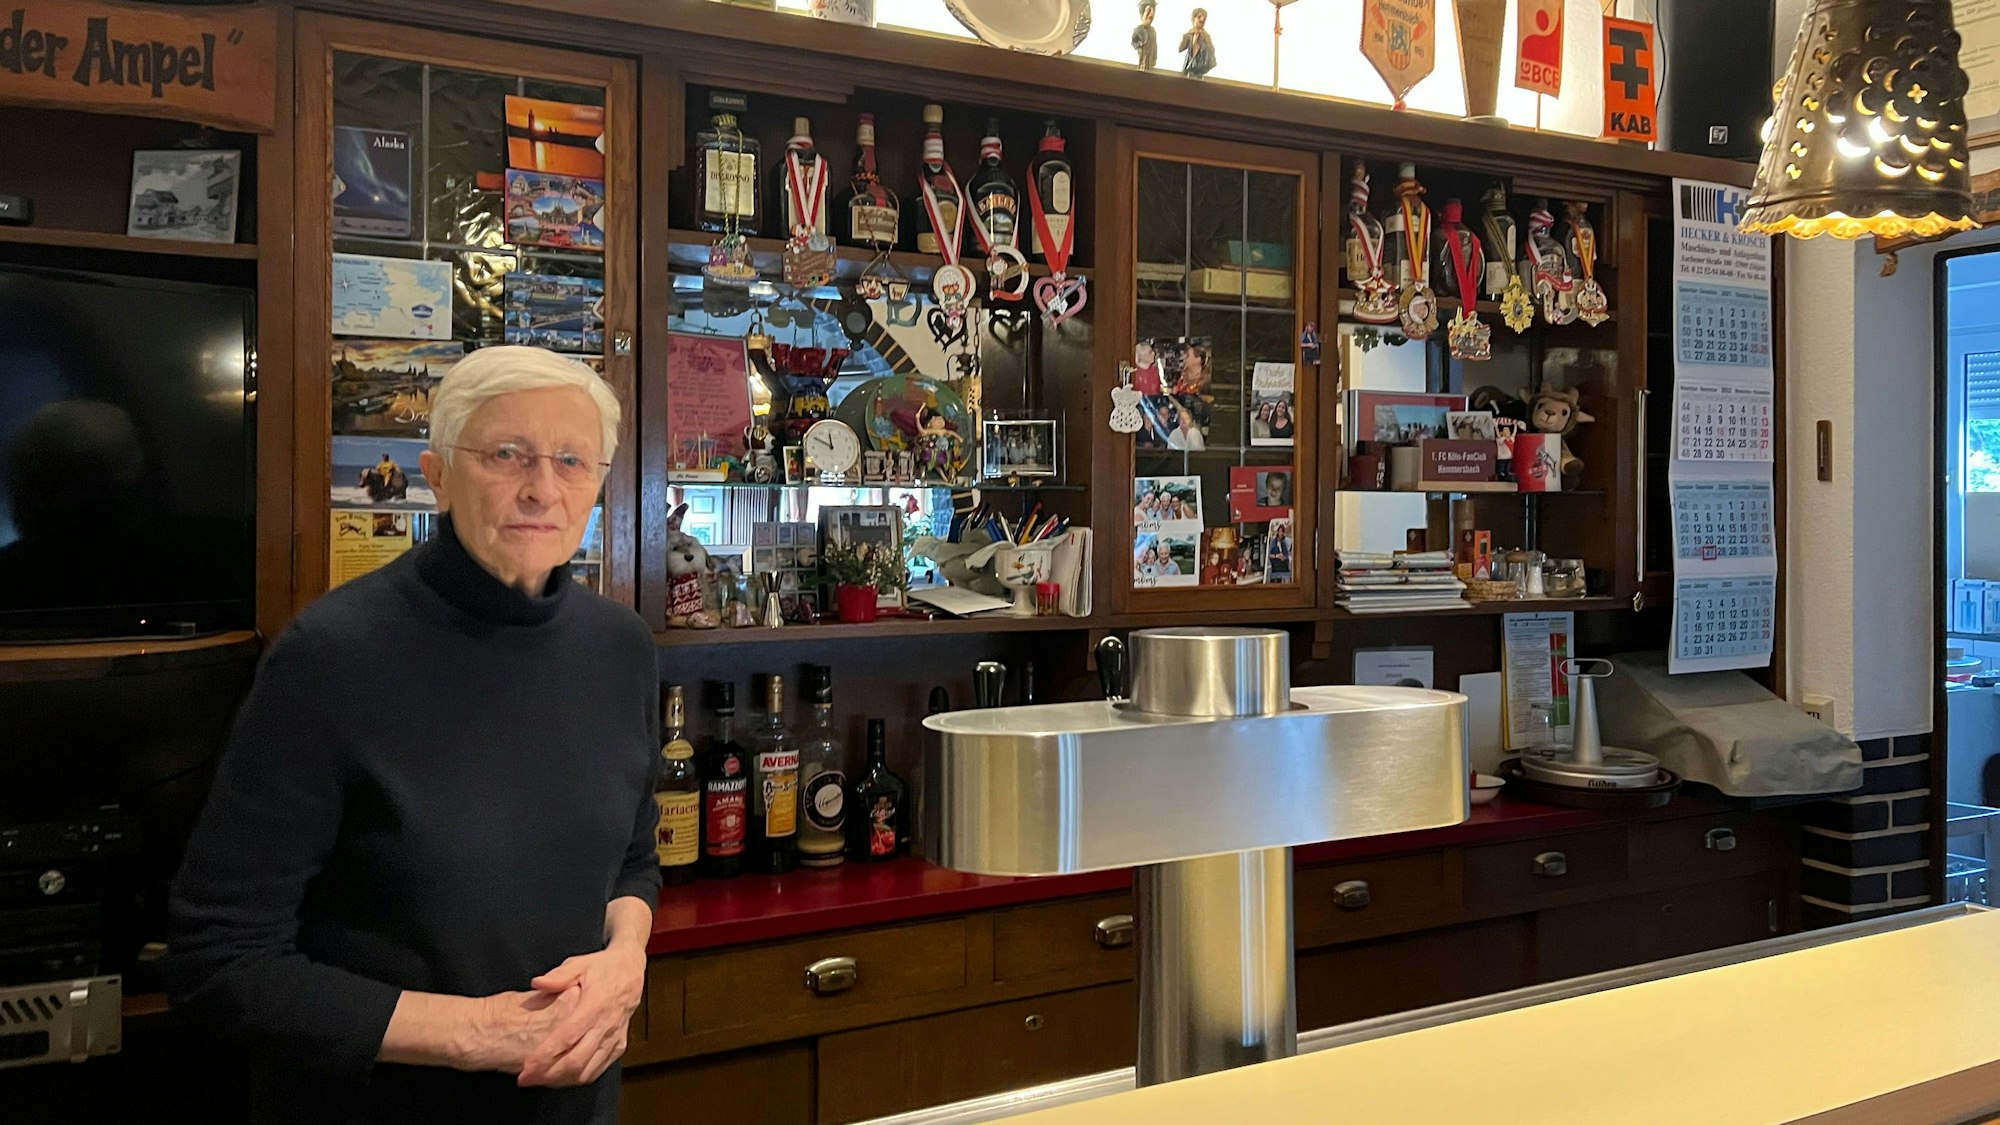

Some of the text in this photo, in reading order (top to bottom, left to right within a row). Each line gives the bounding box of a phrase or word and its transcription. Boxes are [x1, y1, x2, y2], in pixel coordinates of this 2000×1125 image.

[0, 9, 68, 79] der
[1532, 63, 1559, 90] BCE
[1611, 112, 1652, 135] KAB
[373, 136, 405, 149] Alaska
[1681, 226, 1720, 242] HECKER
[1722, 231, 1730, 243] &
[1720, 307, 1723, 316] 1
[1731, 308, 1734, 317] 2
[1742, 309, 1745, 318] 3
[1696, 317, 1701, 325] 6
[1708, 317, 1712, 326] 7
[1720, 318, 1724, 327] 8
[1731, 320, 1735, 328] 9
[1695, 328, 1703, 337] 13
[1719, 330, 1726, 339] 15
[1694, 340, 1748, 352] 20 21 22 23 24
[1694, 351, 1704, 360] 27
[1706, 352, 1715, 361] 28
[1718, 353, 1726, 362] 29
[395, 406, 430, 424] Dre
[1719, 404, 1722, 413] 2
[1730, 405, 1734, 413] 3
[1763, 406, 1766, 415] 6
[1696, 414, 1699, 423] 7
[1707, 415, 1711, 424] 8
[1719, 415, 1722, 424] 9
[1729, 416, 1736, 425] 10
[1740, 417, 1746, 425] 11
[1751, 417, 1757, 426] 12
[1762, 417, 1768, 427] 13
[1694, 426, 1701, 434] 14
[1706, 426, 1712, 435] 15
[1729, 427, 1736, 436] 17
[1740, 428, 1746, 437] 18
[1761, 428, 1768, 438] 20
[1693, 437, 1700, 447] 21
[1705, 438, 1712, 447] 22
[1716, 438, 1724, 447] 23
[1727, 439, 1735, 447] 24
[1739, 440, 1746, 448] 25
[1760, 440, 1768, 449] 27
[1693, 449, 1701, 458] 28
[1705, 450, 1713, 458] 29
[1716, 450, 1724, 459] 30
[1729, 501, 1732, 510] 1
[1740, 501, 1744, 510] 2
[1694, 513, 1698, 522] 5
[1706, 513, 1710, 521] 6
[1718, 512, 1722, 521] 7
[1730, 512, 1734, 521] 8
[1741, 512, 1745, 521] 9
[1693, 524, 1701, 533] 12
[1705, 524, 1713, 533] 13
[1729, 524, 1736, 532] 15
[1740, 524, 1747, 532] 16
[1694, 536, 1701, 545] 19
[1705, 536, 1714, 544] 20
[1717, 536, 1724, 544] 21
[1729, 535, 1736, 544] 22
[1740, 535, 1748, 544] 23
[1717, 547, 1726, 556] 28
[1729, 547, 1737, 555] 29
[1740, 546, 1748, 555] 30
[1696, 600, 1700, 609] 2
[1708, 600, 1712, 608] 3
[1731, 598, 1735, 607] 5
[1696, 612, 1700, 620] 9
[1707, 611, 1714, 620] 10
[1718, 611, 1724, 619] 11
[1730, 610, 1737, 618] 12
[1741, 609, 1748, 617] 13
[1695, 623, 1702, 632] 16
[1707, 622, 1714, 631] 17
[1718, 622, 1725, 630] 18
[1730, 621, 1736, 630] 19
[1740, 620, 1748, 629] 20
[1694, 635, 1702, 644] 23
[1706, 634, 1713, 643] 24
[1717, 633, 1726, 642] 25
[1728, 632, 1736, 641] 26
[1740, 632, 1747, 641] 27
[1694, 646, 1702, 655] 30
[1705, 646, 1712, 654] 31
